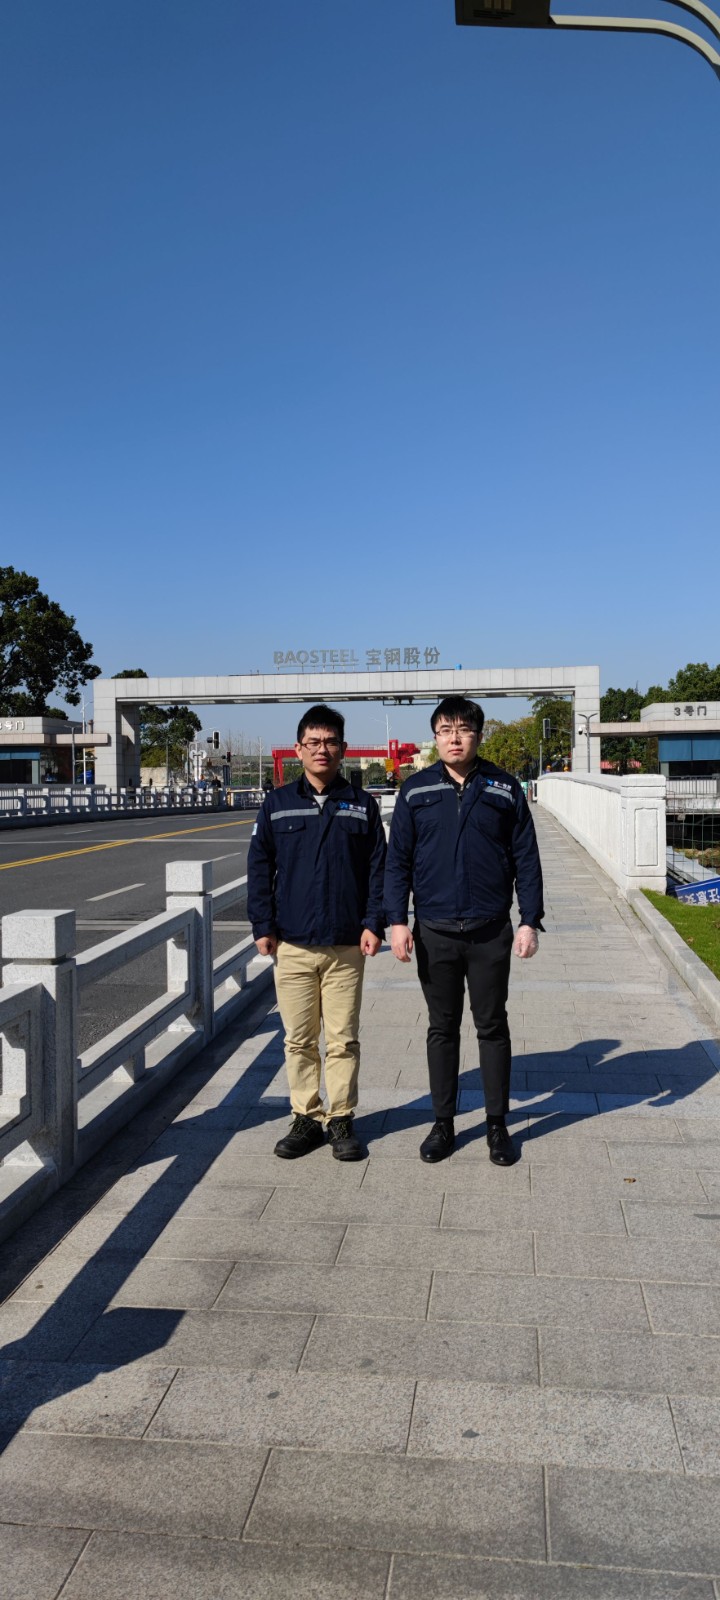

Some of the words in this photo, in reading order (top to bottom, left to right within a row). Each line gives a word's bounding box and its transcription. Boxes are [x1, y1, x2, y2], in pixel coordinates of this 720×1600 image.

[273, 649, 359, 664] BAOSTEEL
[365, 646, 441, 666] 宝钢股份
[674, 705, 707, 716] 3号门
[677, 888, 720, 905] 注意安
